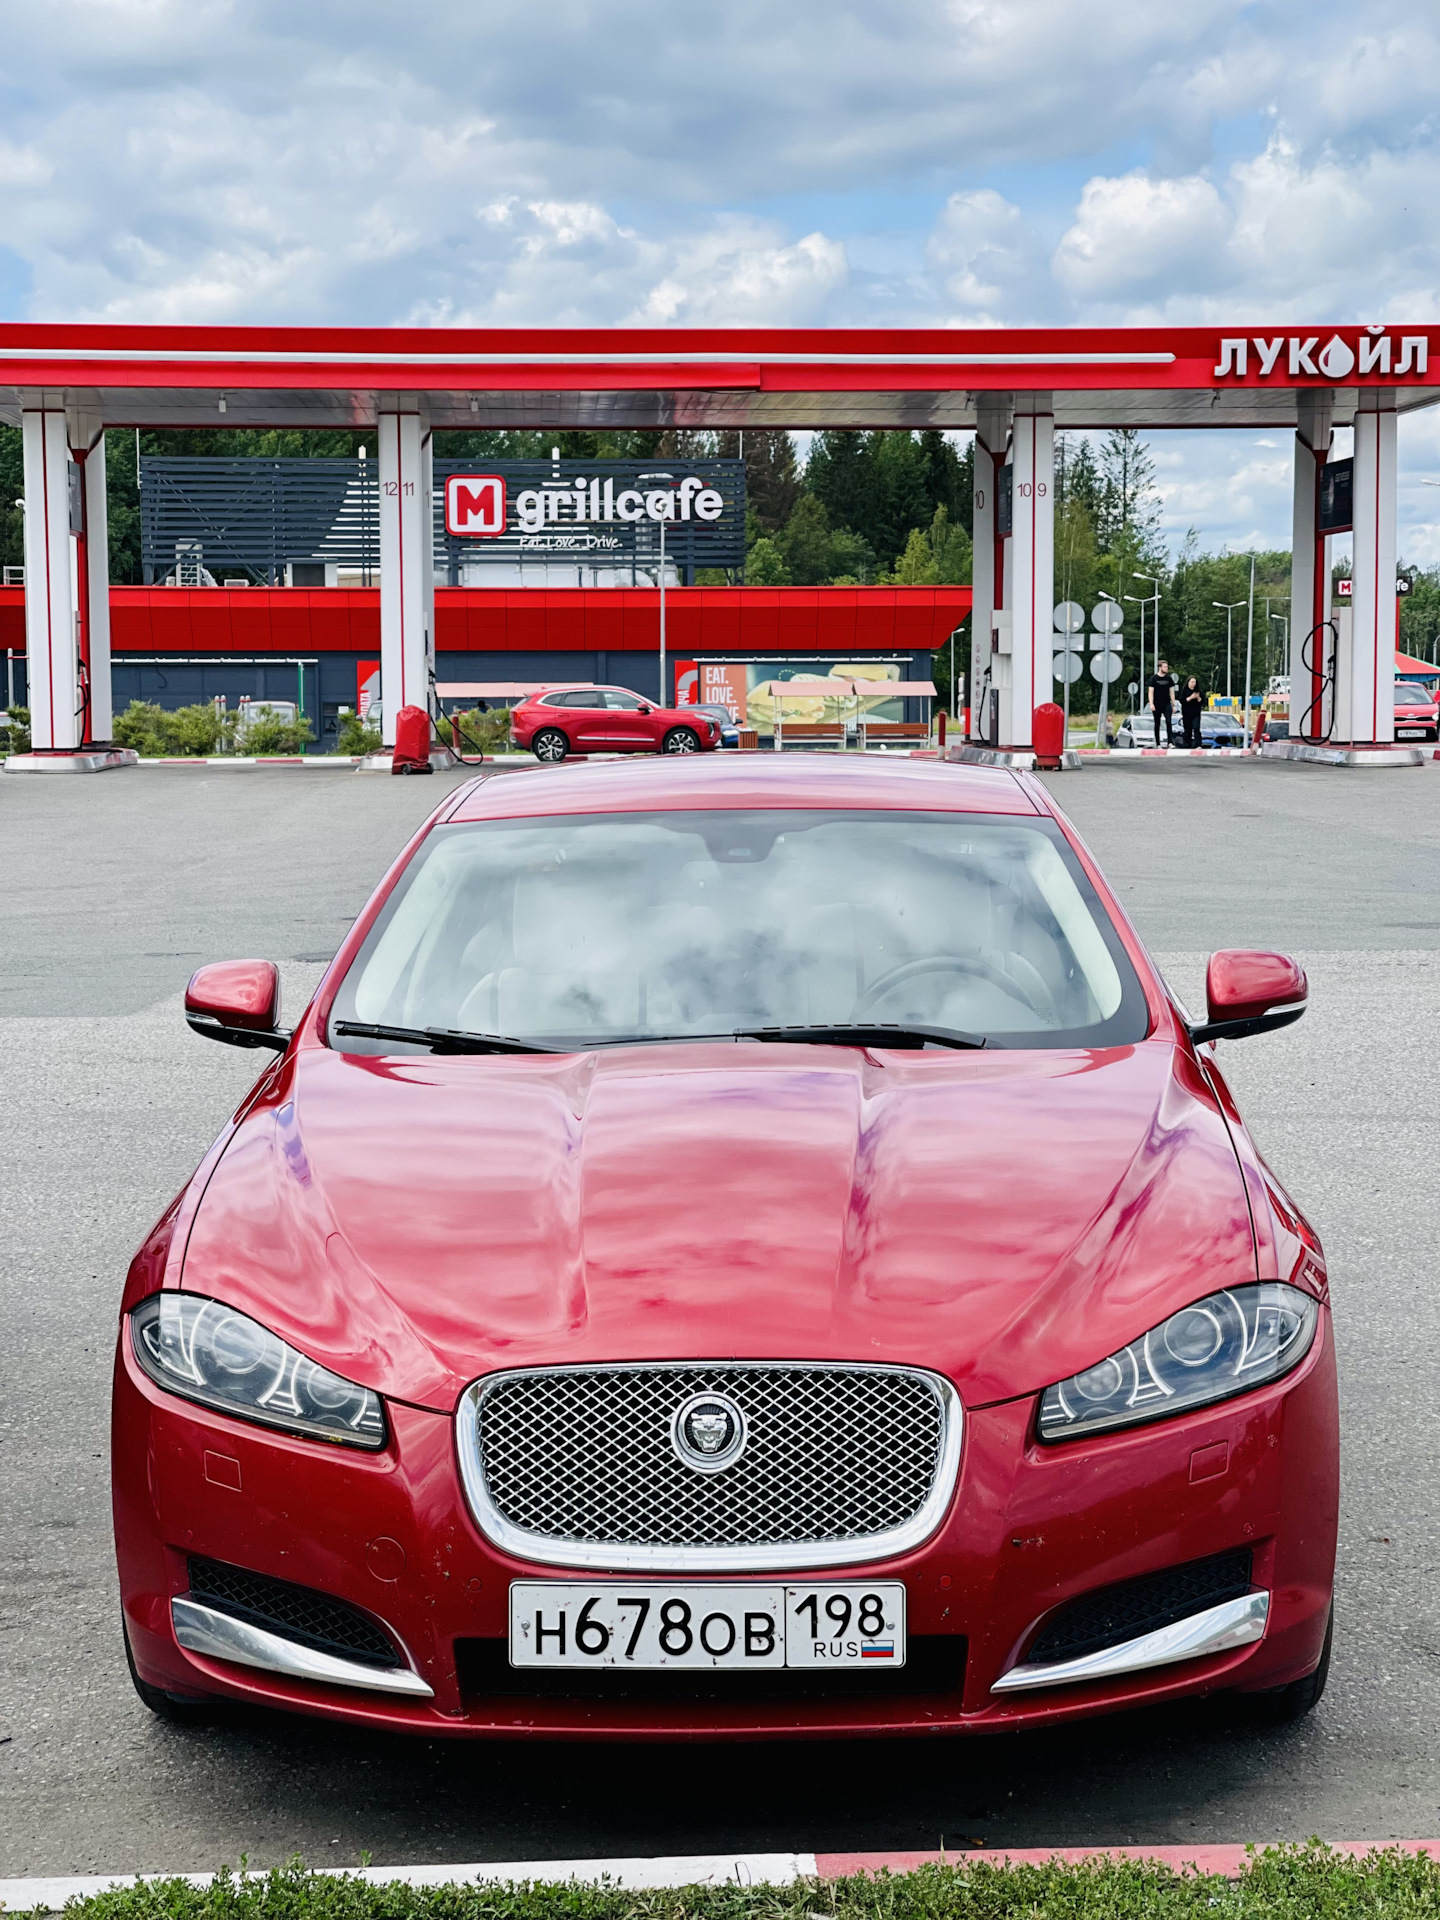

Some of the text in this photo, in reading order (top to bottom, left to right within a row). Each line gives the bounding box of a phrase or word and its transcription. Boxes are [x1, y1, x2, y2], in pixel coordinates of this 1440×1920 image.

[383, 481, 415, 496] 12 11
[1017, 483, 1047, 497] 10 9
[516, 477, 724, 533] grillcafe
[975, 490, 984, 509] 10
[547, 535, 580, 548] Love.
[583, 534, 623, 549] Drive.
[706, 667, 729, 684] EAT.
[706, 687, 737, 704] LOVE.
[685, 1397, 735, 1414] JAGUAR
[535, 1593, 885, 1656] Н678ОВ 198
[814, 1642, 859, 1658] RUS
